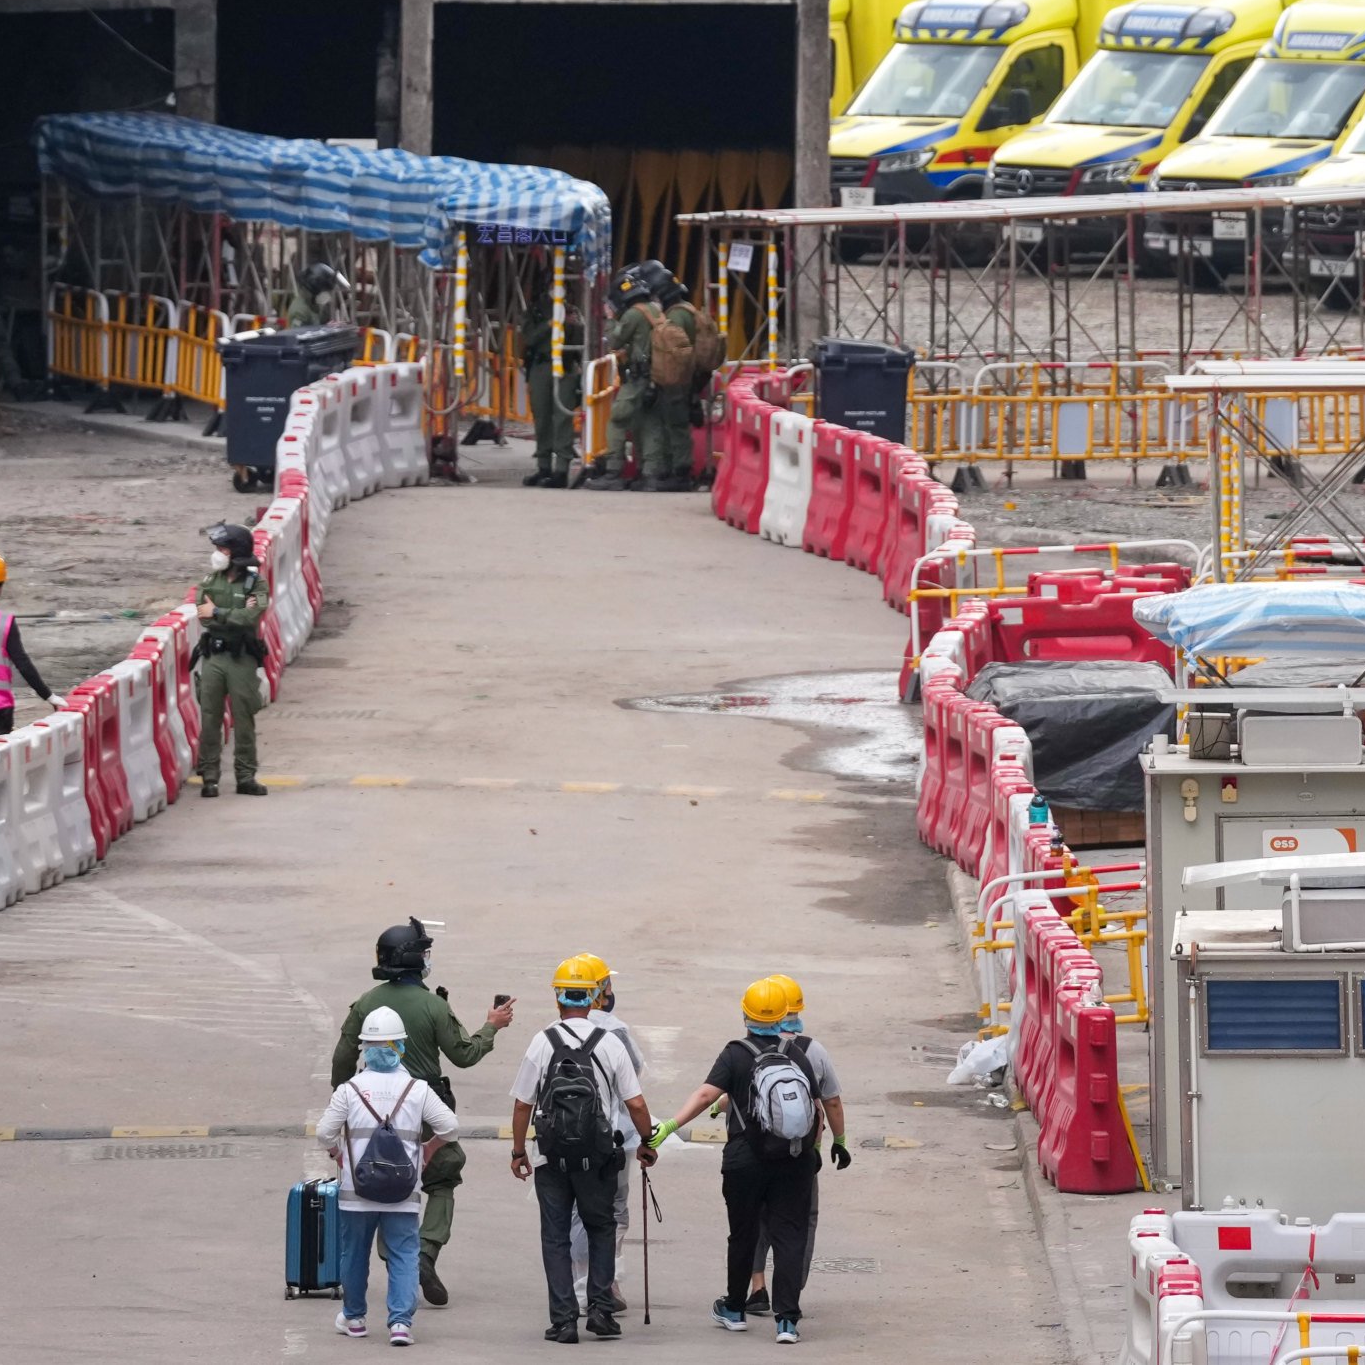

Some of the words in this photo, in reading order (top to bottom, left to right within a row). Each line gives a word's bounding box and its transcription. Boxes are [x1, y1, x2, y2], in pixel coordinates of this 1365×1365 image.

[919, 8, 981, 23] AMBULANCE
[1124, 15, 1186, 32] AMBULANCE
[1288, 34, 1347, 49] AMBULANCE
[1273, 839, 1296, 848] ess
